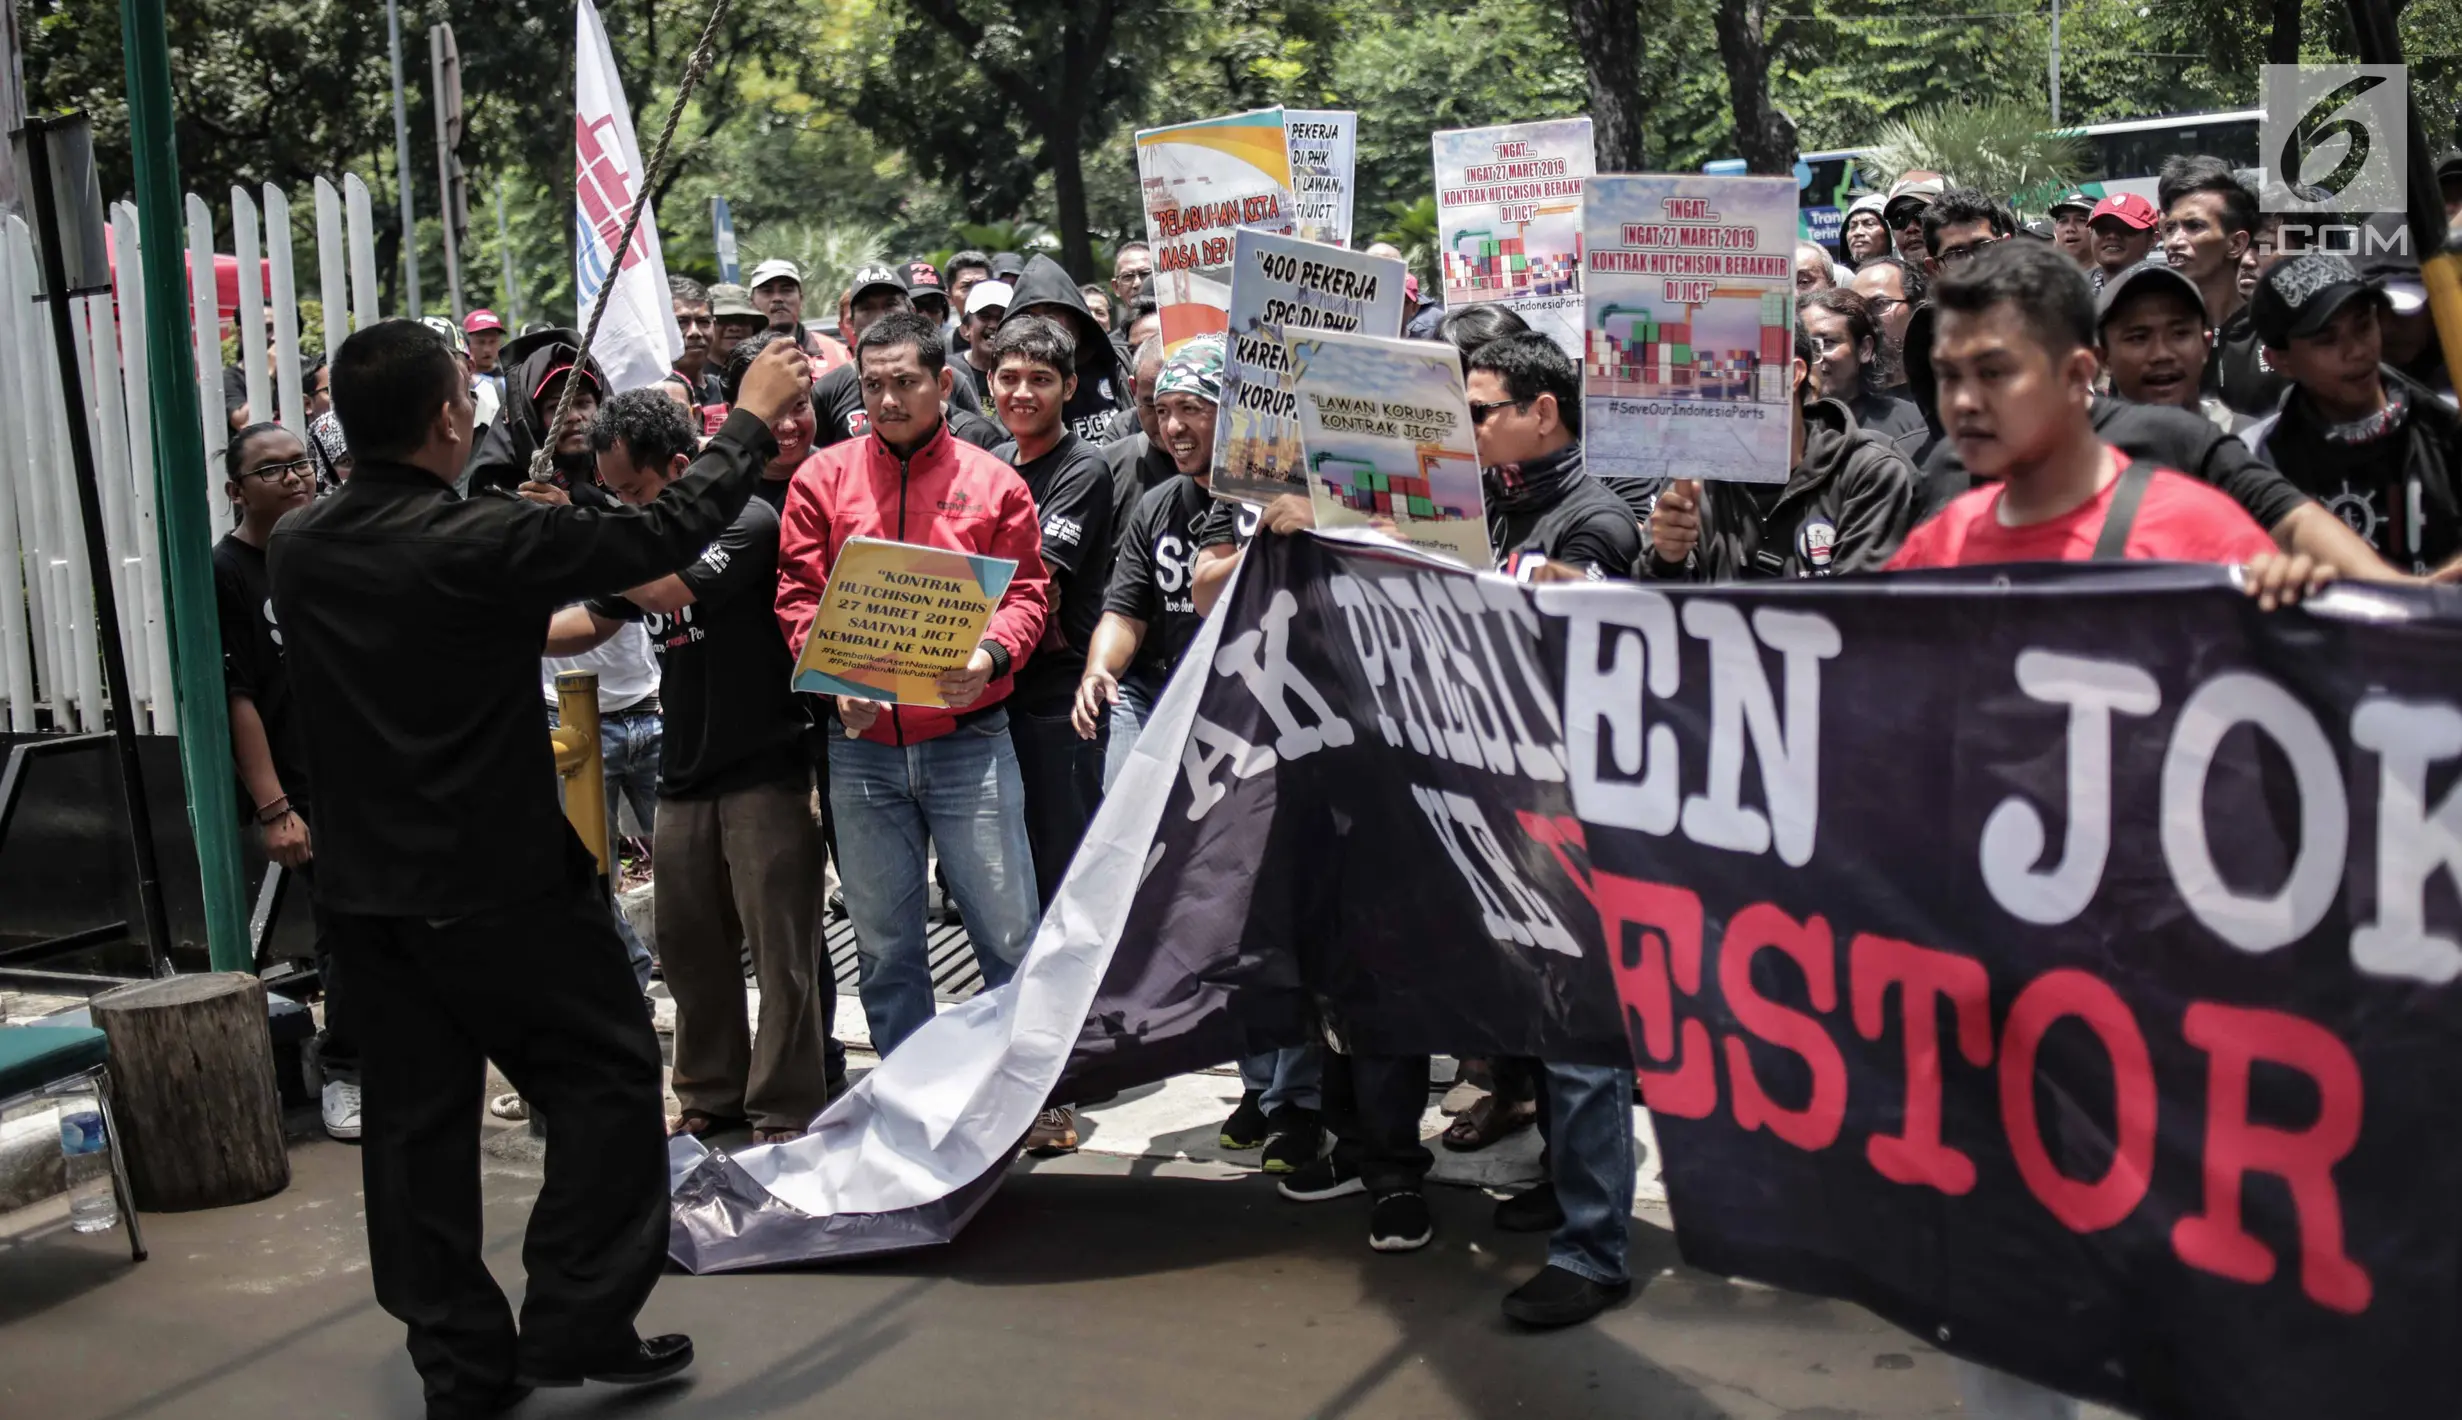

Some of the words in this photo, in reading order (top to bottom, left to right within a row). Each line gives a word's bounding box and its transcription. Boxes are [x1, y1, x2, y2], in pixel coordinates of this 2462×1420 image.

[1292, 123, 1339, 140] PEKERJA
[1293, 150, 1304, 165] DI
[1307, 150, 1329, 166] PHK
[1466, 167, 1495, 183] INGAT
[1495, 165, 1506, 180] 27
[1508, 162, 1539, 179] MARET
[1541, 160, 1565, 176] 2019
[1303, 177, 1340, 193] LAWAN
[1444, 187, 1487, 205] KONTRAK
[1488, 182, 1542, 202] HUTCHISON
[1153, 199, 1240, 237] "PELABUHAN
[1243, 194, 1280, 224] KITA
[1501, 207, 1512, 222] DI
[1624, 225, 1659, 245] INGAT
[1662, 226, 1676, 246] 27
[1680, 227, 1720, 247] MARET
[1724, 228, 1755, 248] 2019
[1159, 243, 1200, 272] MASA
[1591, 251, 1648, 272] KONTRAK
[1651, 253, 1721, 274] HUTCHISON
[1725, 255, 1787, 276] BERAKHIR
[1256, 250, 1297, 283] "400
[1300, 260, 1377, 302] PEKERJA
[1666, 281, 1679, 299] DI
[1263, 298, 1297, 325] SPC
[1300, 306, 1319, 328] DI
[1238, 381, 1298, 421] KORUP
[1609, 401, 1765, 420] #SaveOurIndonesiaPorts
[1320, 412, 1397, 436] KONTRAK
[1382, 401, 1457, 426] KORUPSI
[878, 568, 964, 594] "KONTRAK
[838, 580, 934, 607] HUTCHISON
[937, 594, 988, 614] HABIS
[837, 598, 861, 611] 27
[865, 602, 918, 621] MARET
[818, 628, 888, 650] KEMBALI
[893, 641, 915, 654] KE
[848, 617, 917, 638] SAATNYA
[920, 629, 956, 642] JICT
